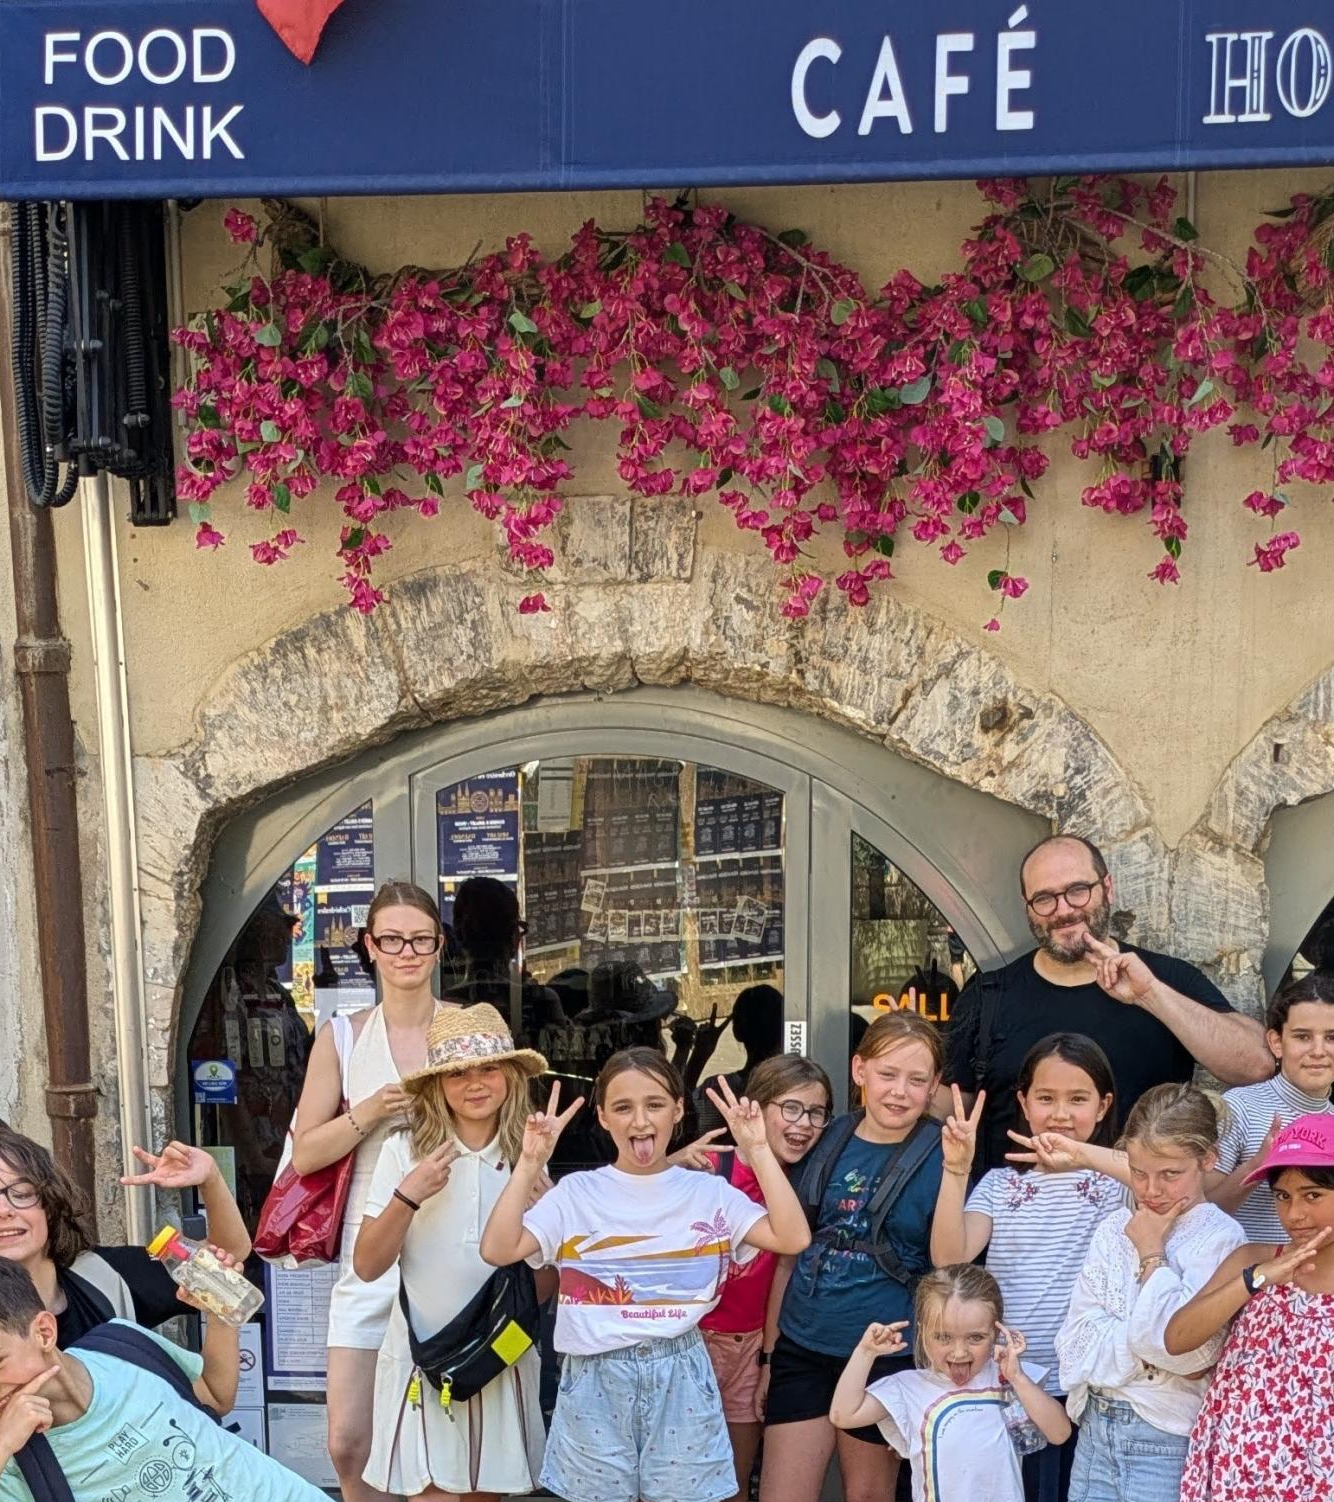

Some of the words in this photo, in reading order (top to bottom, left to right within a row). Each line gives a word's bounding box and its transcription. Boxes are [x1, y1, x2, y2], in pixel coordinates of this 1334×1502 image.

[44, 28, 236, 86] FOOD
[790, 4, 1036, 139] CAFÉ
[34, 104, 246, 162] DRINK
[620, 1308, 666, 1320] Beautiful
[107, 1430, 131, 1451] PLAY
[117, 1437, 140, 1459] HARD
